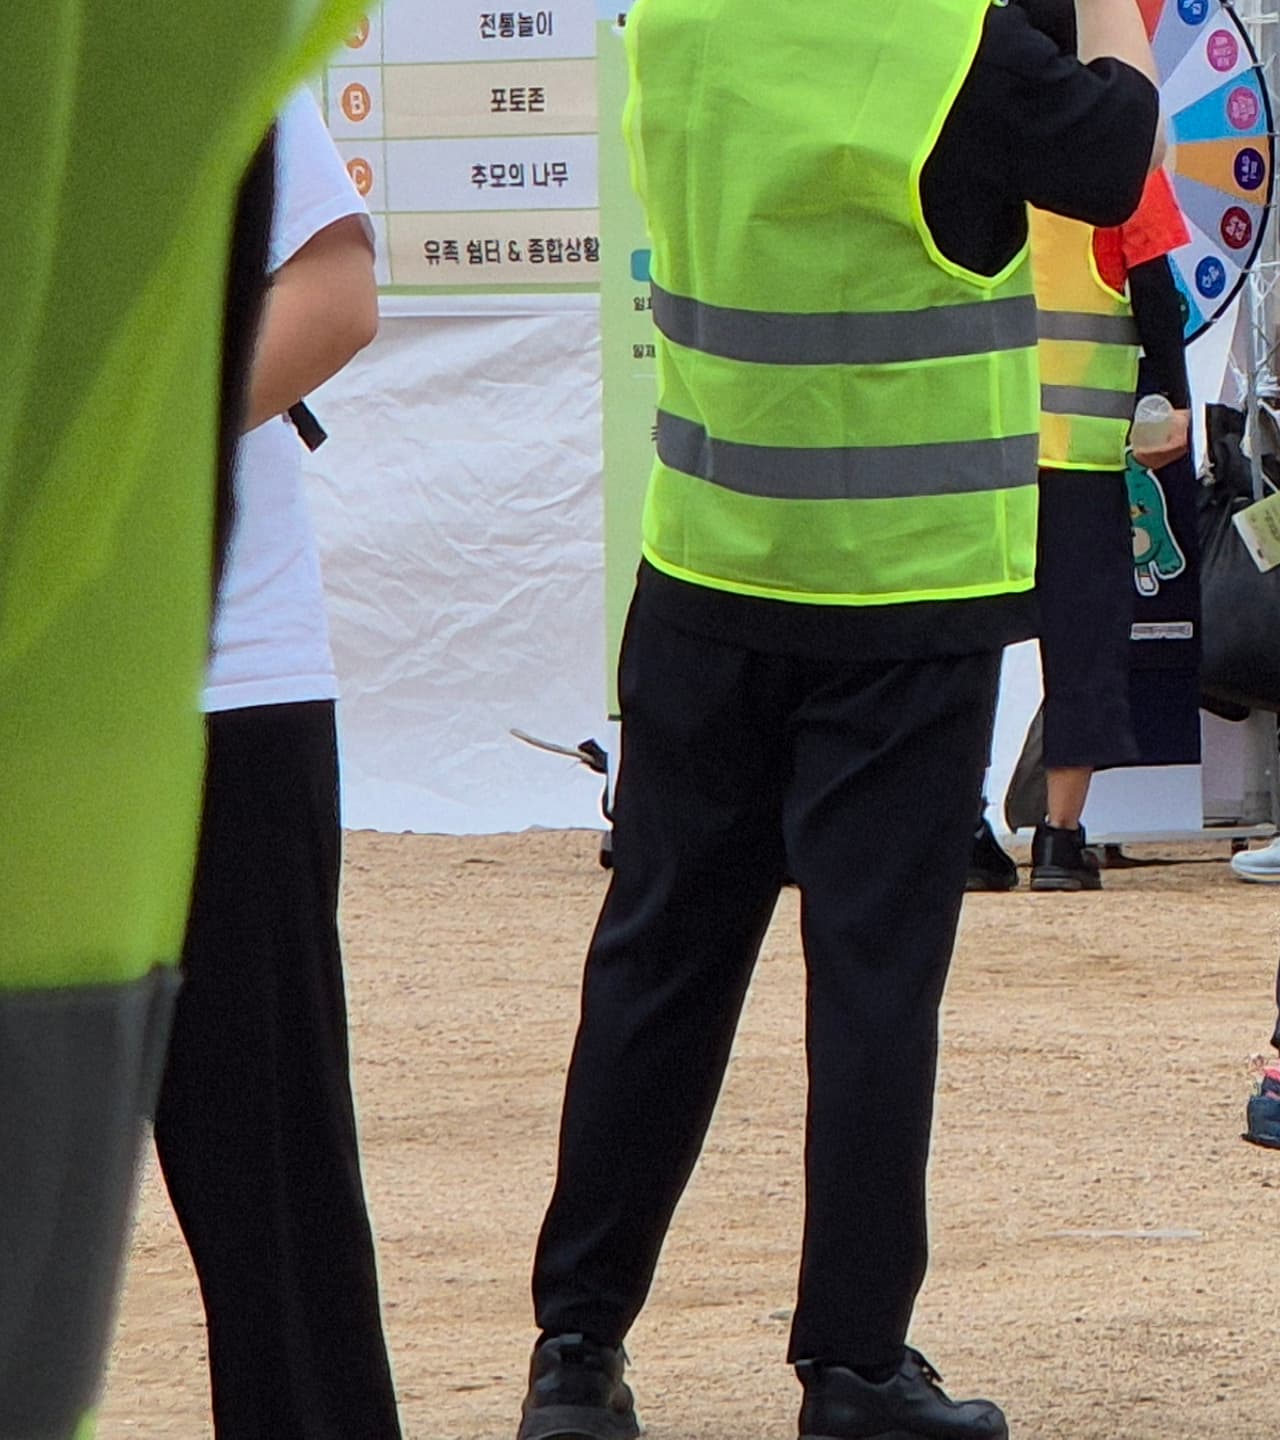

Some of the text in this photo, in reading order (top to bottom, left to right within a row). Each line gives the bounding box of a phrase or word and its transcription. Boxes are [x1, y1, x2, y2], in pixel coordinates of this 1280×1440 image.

[479, 10, 553, 40] 전통놀이
[349, 87, 546, 116] B 포토존
[470, 164, 525, 190] 추모의
[531, 161, 570, 187] 나무
[423, 237, 600, 266] 유족 쉼터 & 종합상황
